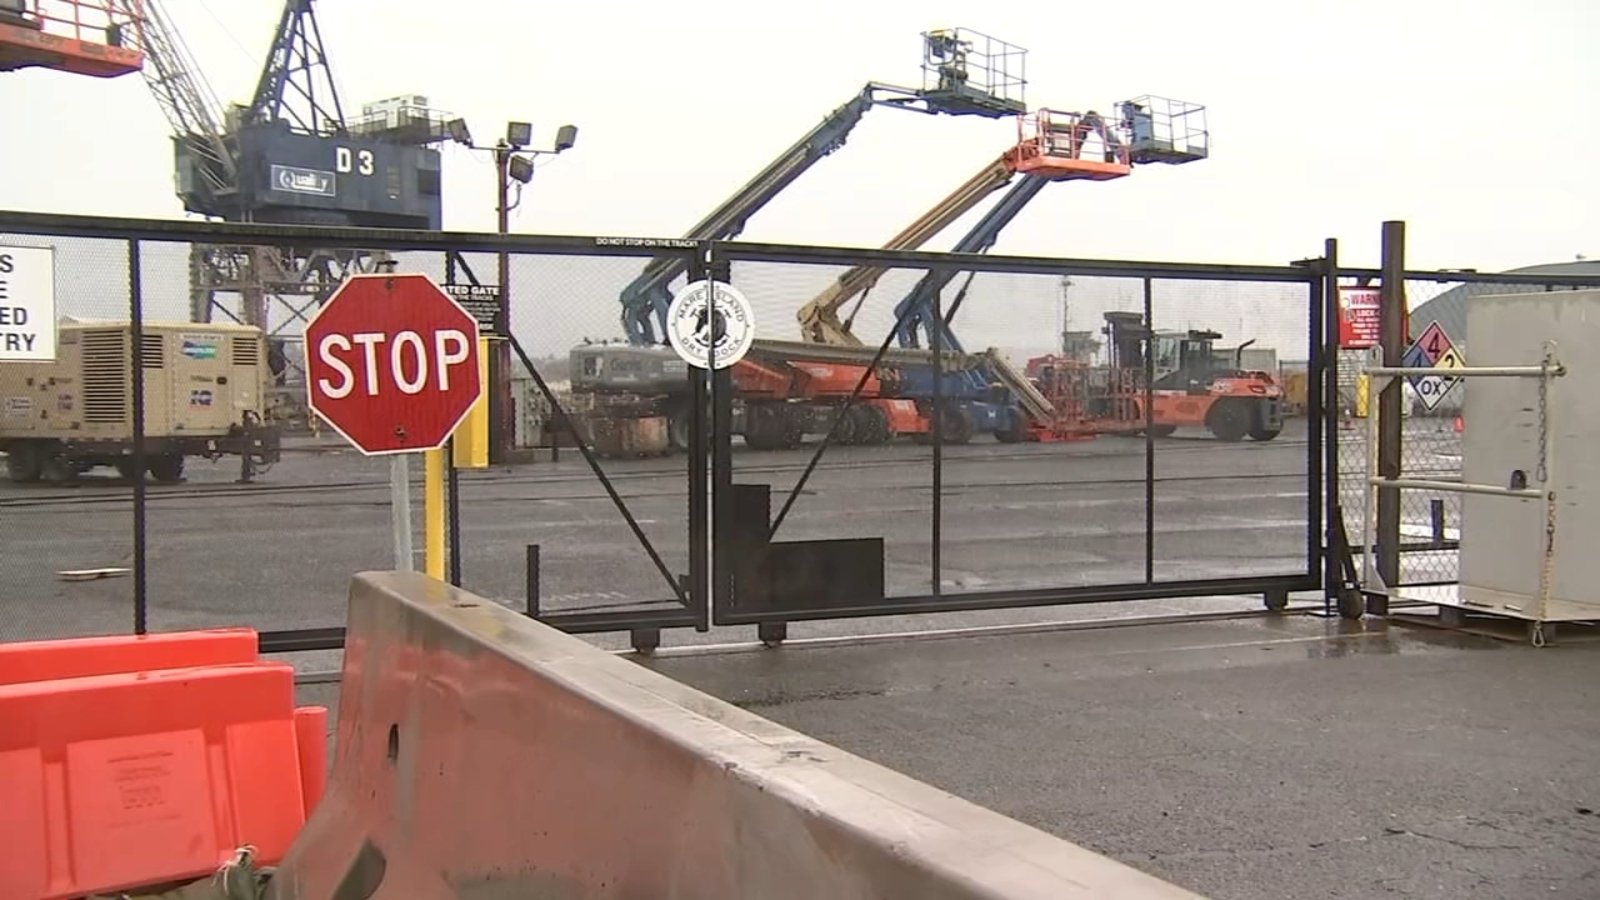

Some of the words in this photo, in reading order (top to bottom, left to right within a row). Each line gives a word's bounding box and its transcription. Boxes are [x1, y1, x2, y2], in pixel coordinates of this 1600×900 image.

[336, 147, 352, 173] D
[359, 150, 374, 176] 3
[470, 286, 499, 295] GATE
[0, 306, 28, 326] ED
[679, 288, 705, 319] MARE
[710, 288, 745, 322] SLAND
[0, 332, 36, 351] RY
[1428, 332, 1441, 360] 4
[319, 329, 470, 399] STOP
[1444, 353, 1455, 382] 2
[1421, 380, 1440, 396] OX
